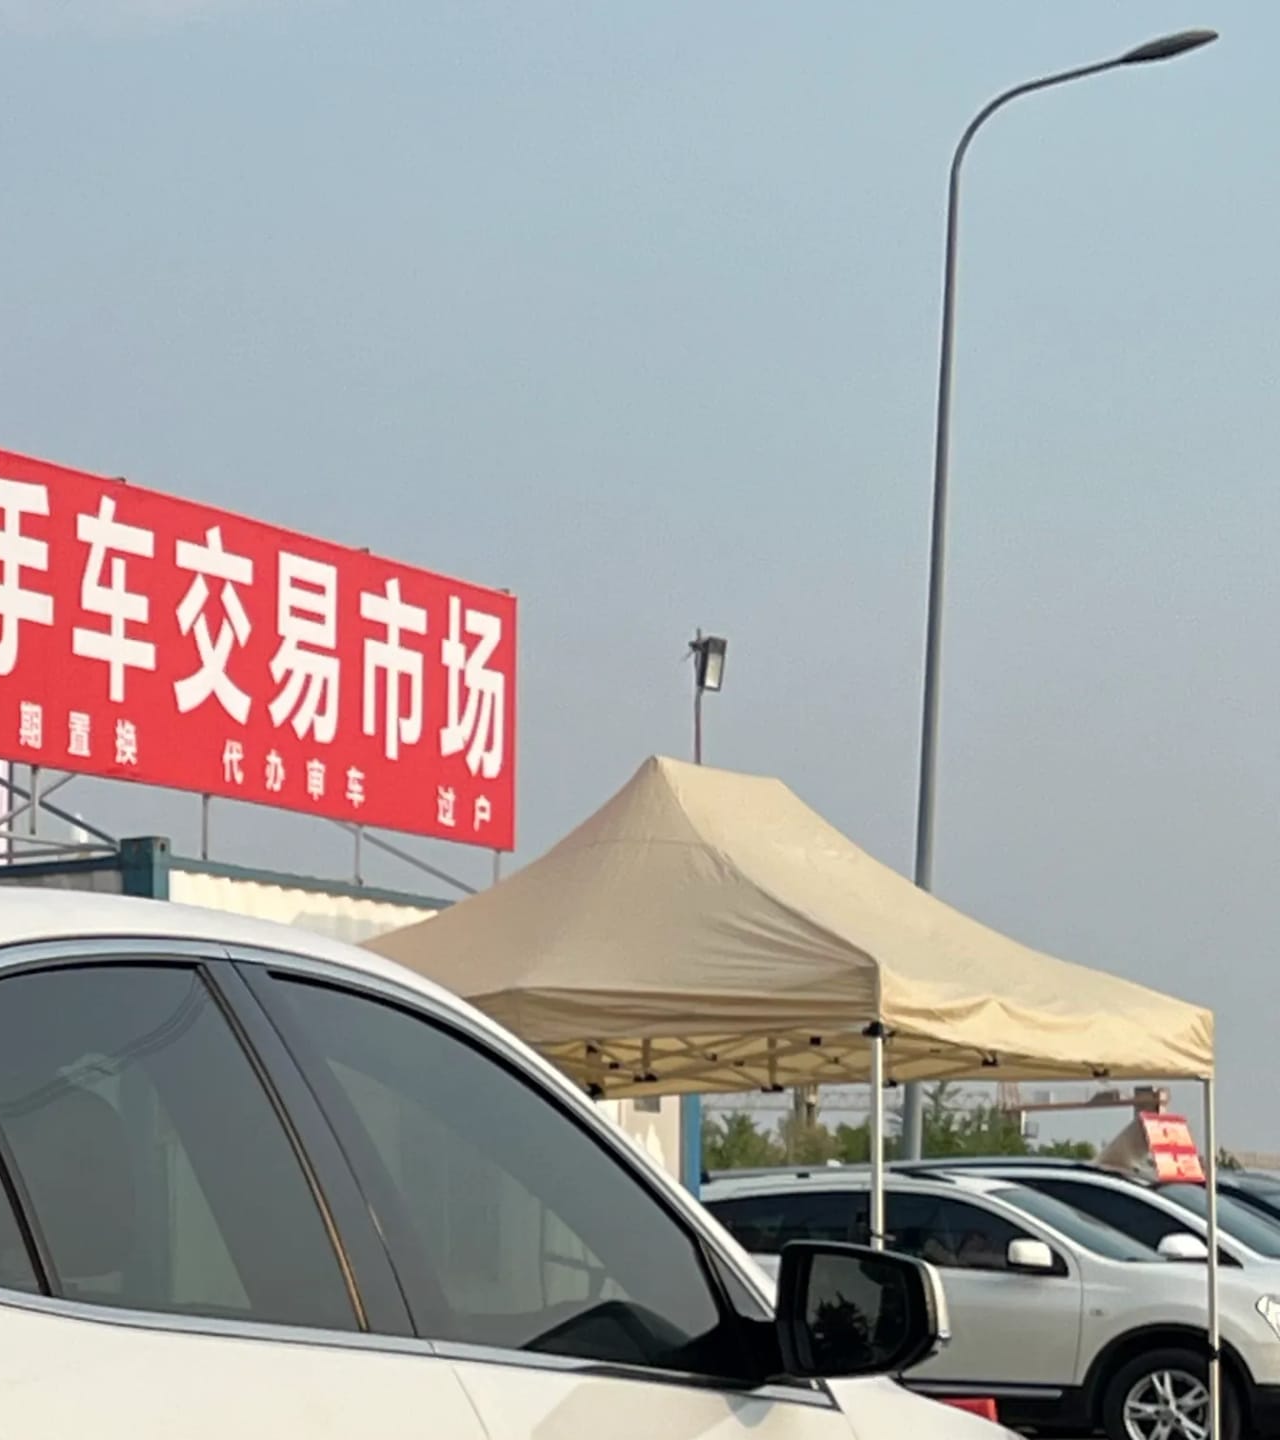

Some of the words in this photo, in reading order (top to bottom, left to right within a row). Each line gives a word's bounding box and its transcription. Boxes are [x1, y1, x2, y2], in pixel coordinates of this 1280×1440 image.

[222, 738, 366, 809] 代办审车
[437, 785, 492, 832] 过户
